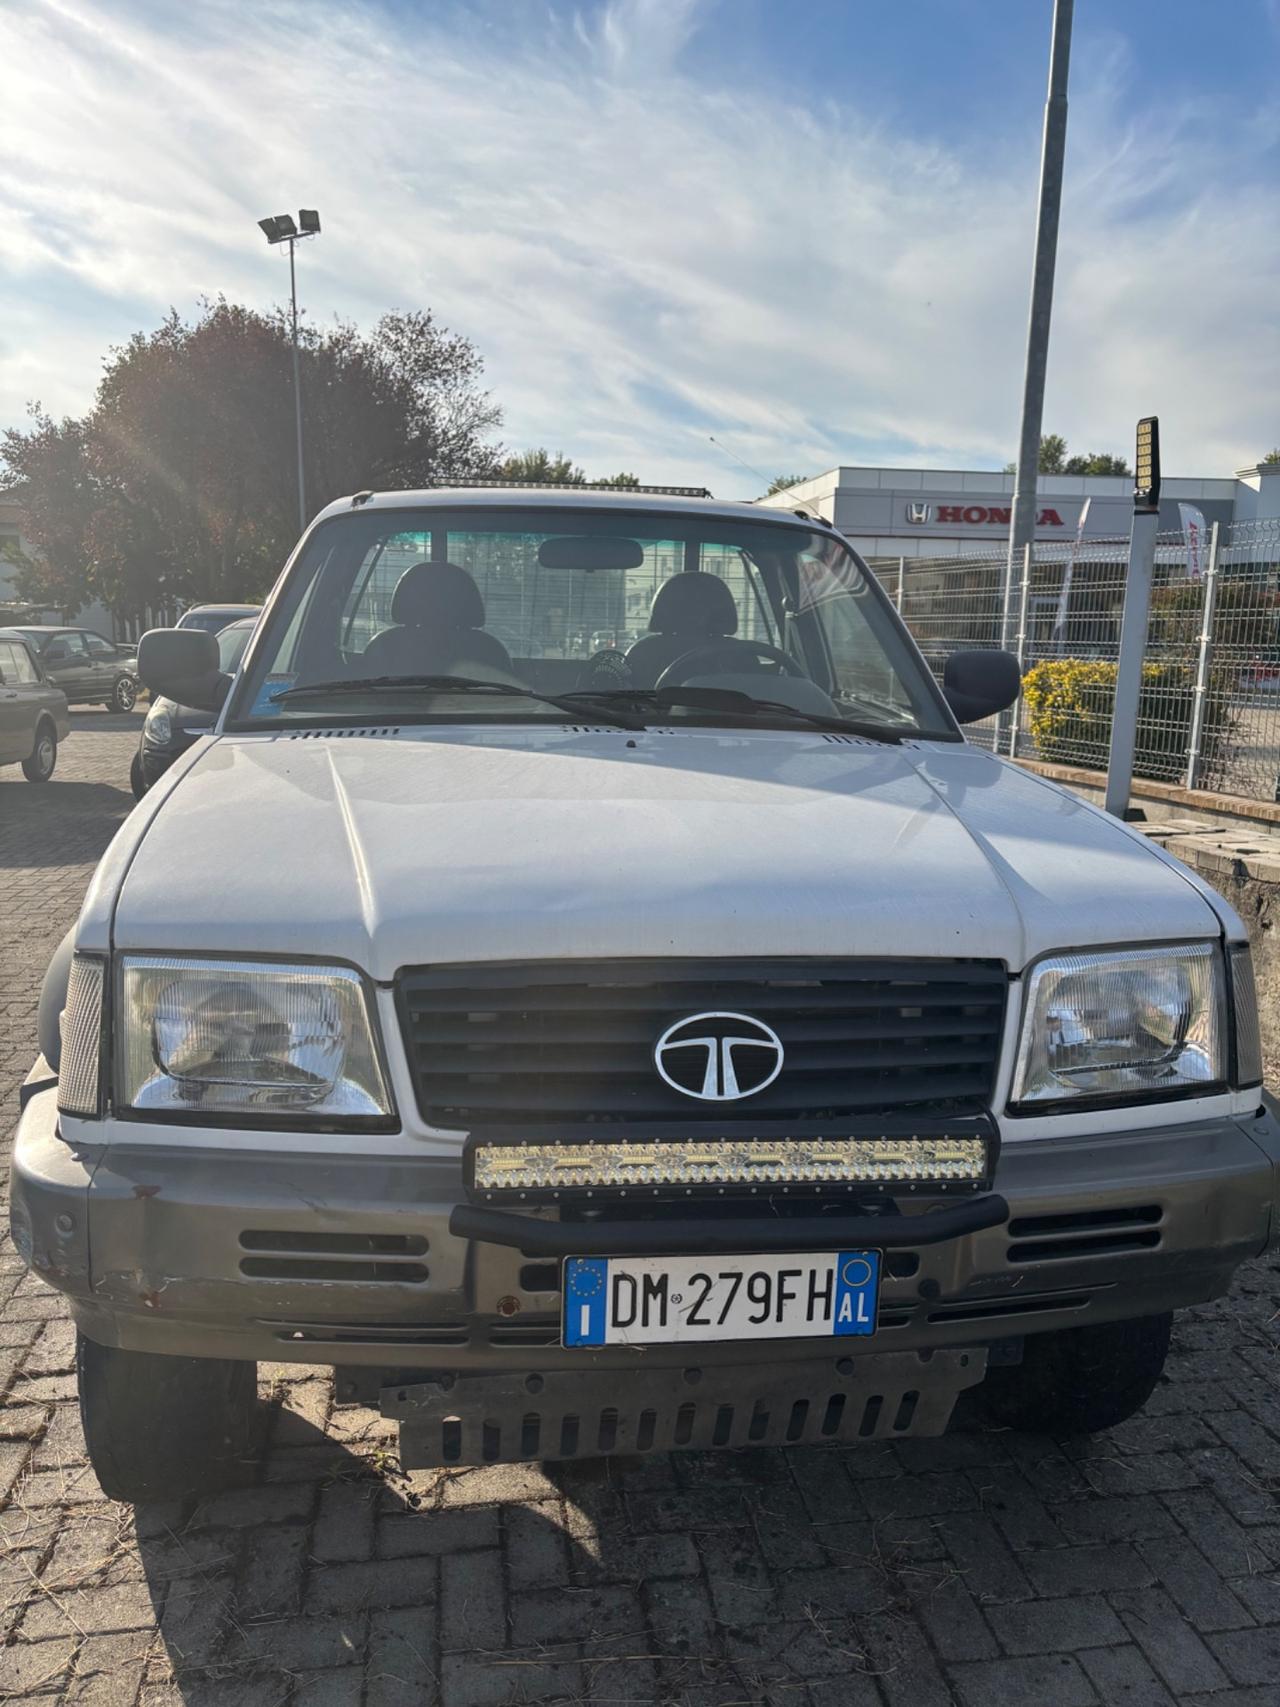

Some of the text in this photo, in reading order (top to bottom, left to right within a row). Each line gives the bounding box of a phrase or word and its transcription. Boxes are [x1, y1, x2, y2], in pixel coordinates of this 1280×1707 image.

[936, 506, 1064, 526] HONA
[580, 1304, 590, 1336] I
[837, 1292, 870, 1323] AL
